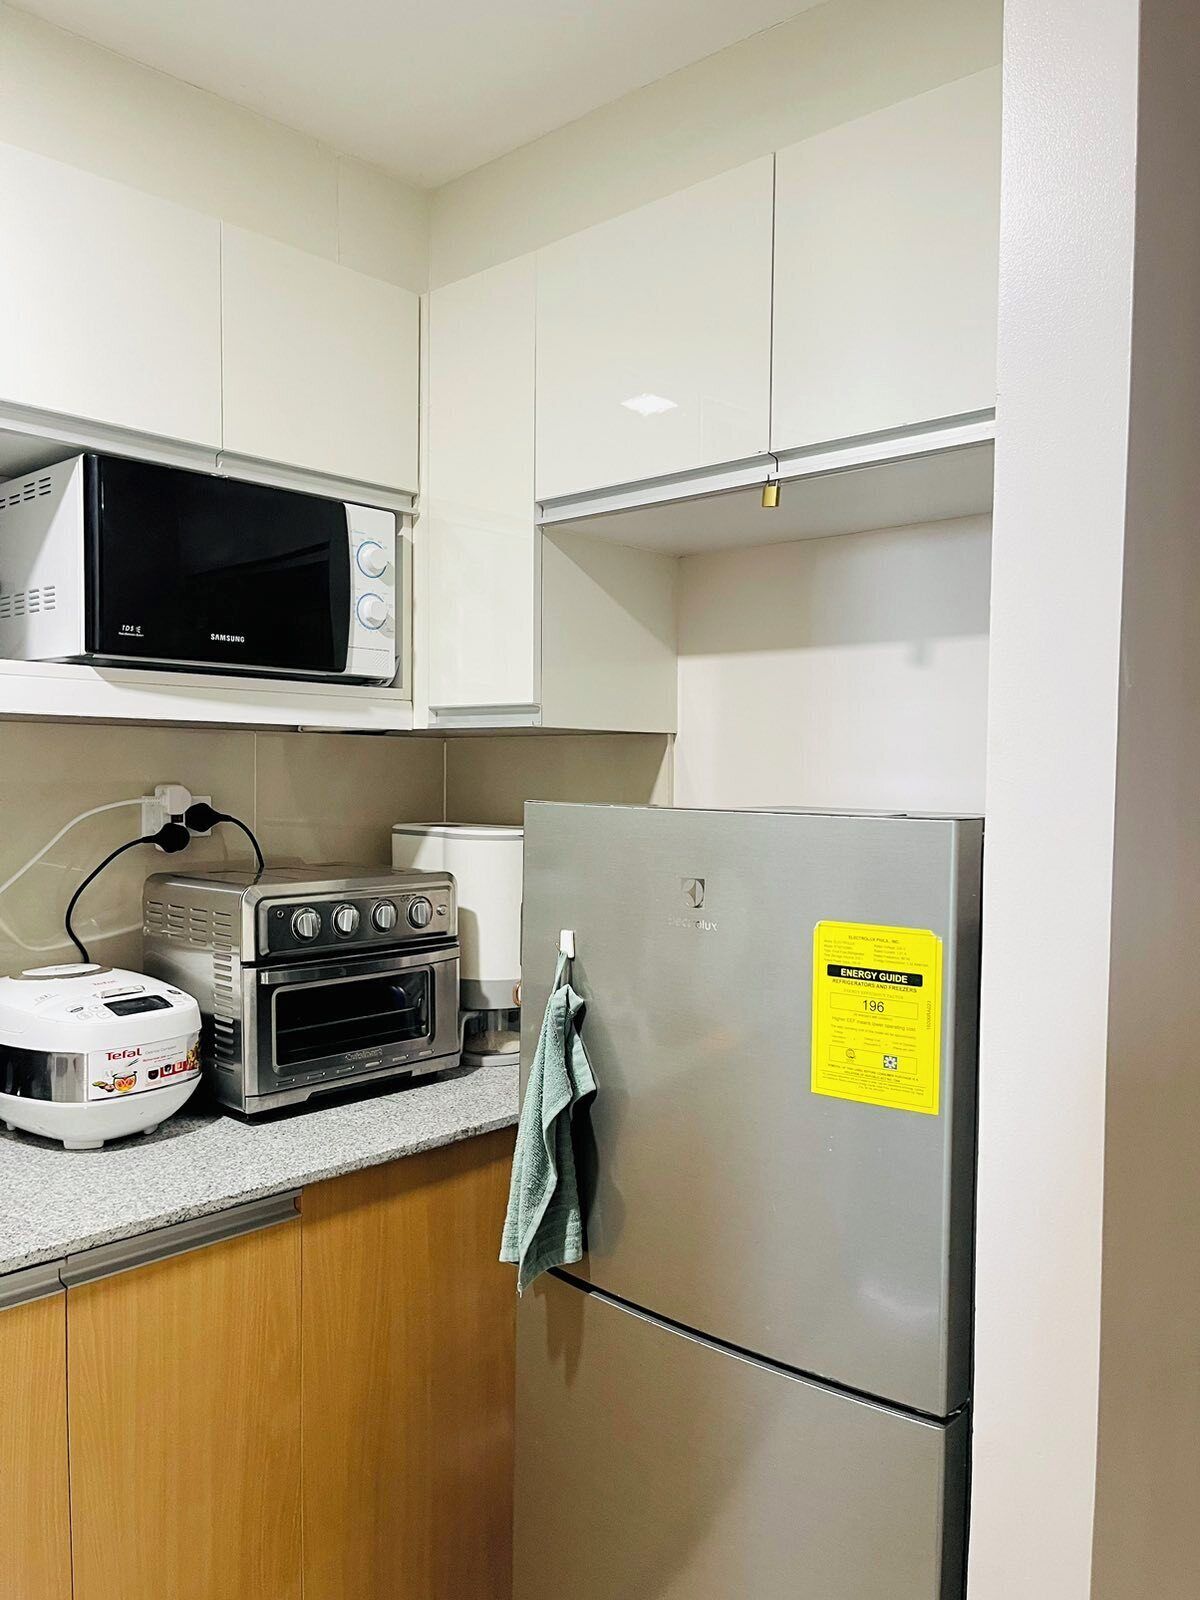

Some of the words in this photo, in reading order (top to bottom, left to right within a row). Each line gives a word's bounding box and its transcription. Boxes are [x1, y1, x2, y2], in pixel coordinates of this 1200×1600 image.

[210, 633, 245, 643] SAMSUNG
[840, 967, 877, 980] ENERGY
[878, 972, 908, 984] GUIDE
[832, 979, 875, 988] REFRIGERATORS
[888, 985, 917, 993] FREEZERS
[863, 1000, 885, 1013] 196
[105, 1047, 142, 1060] Tefal
